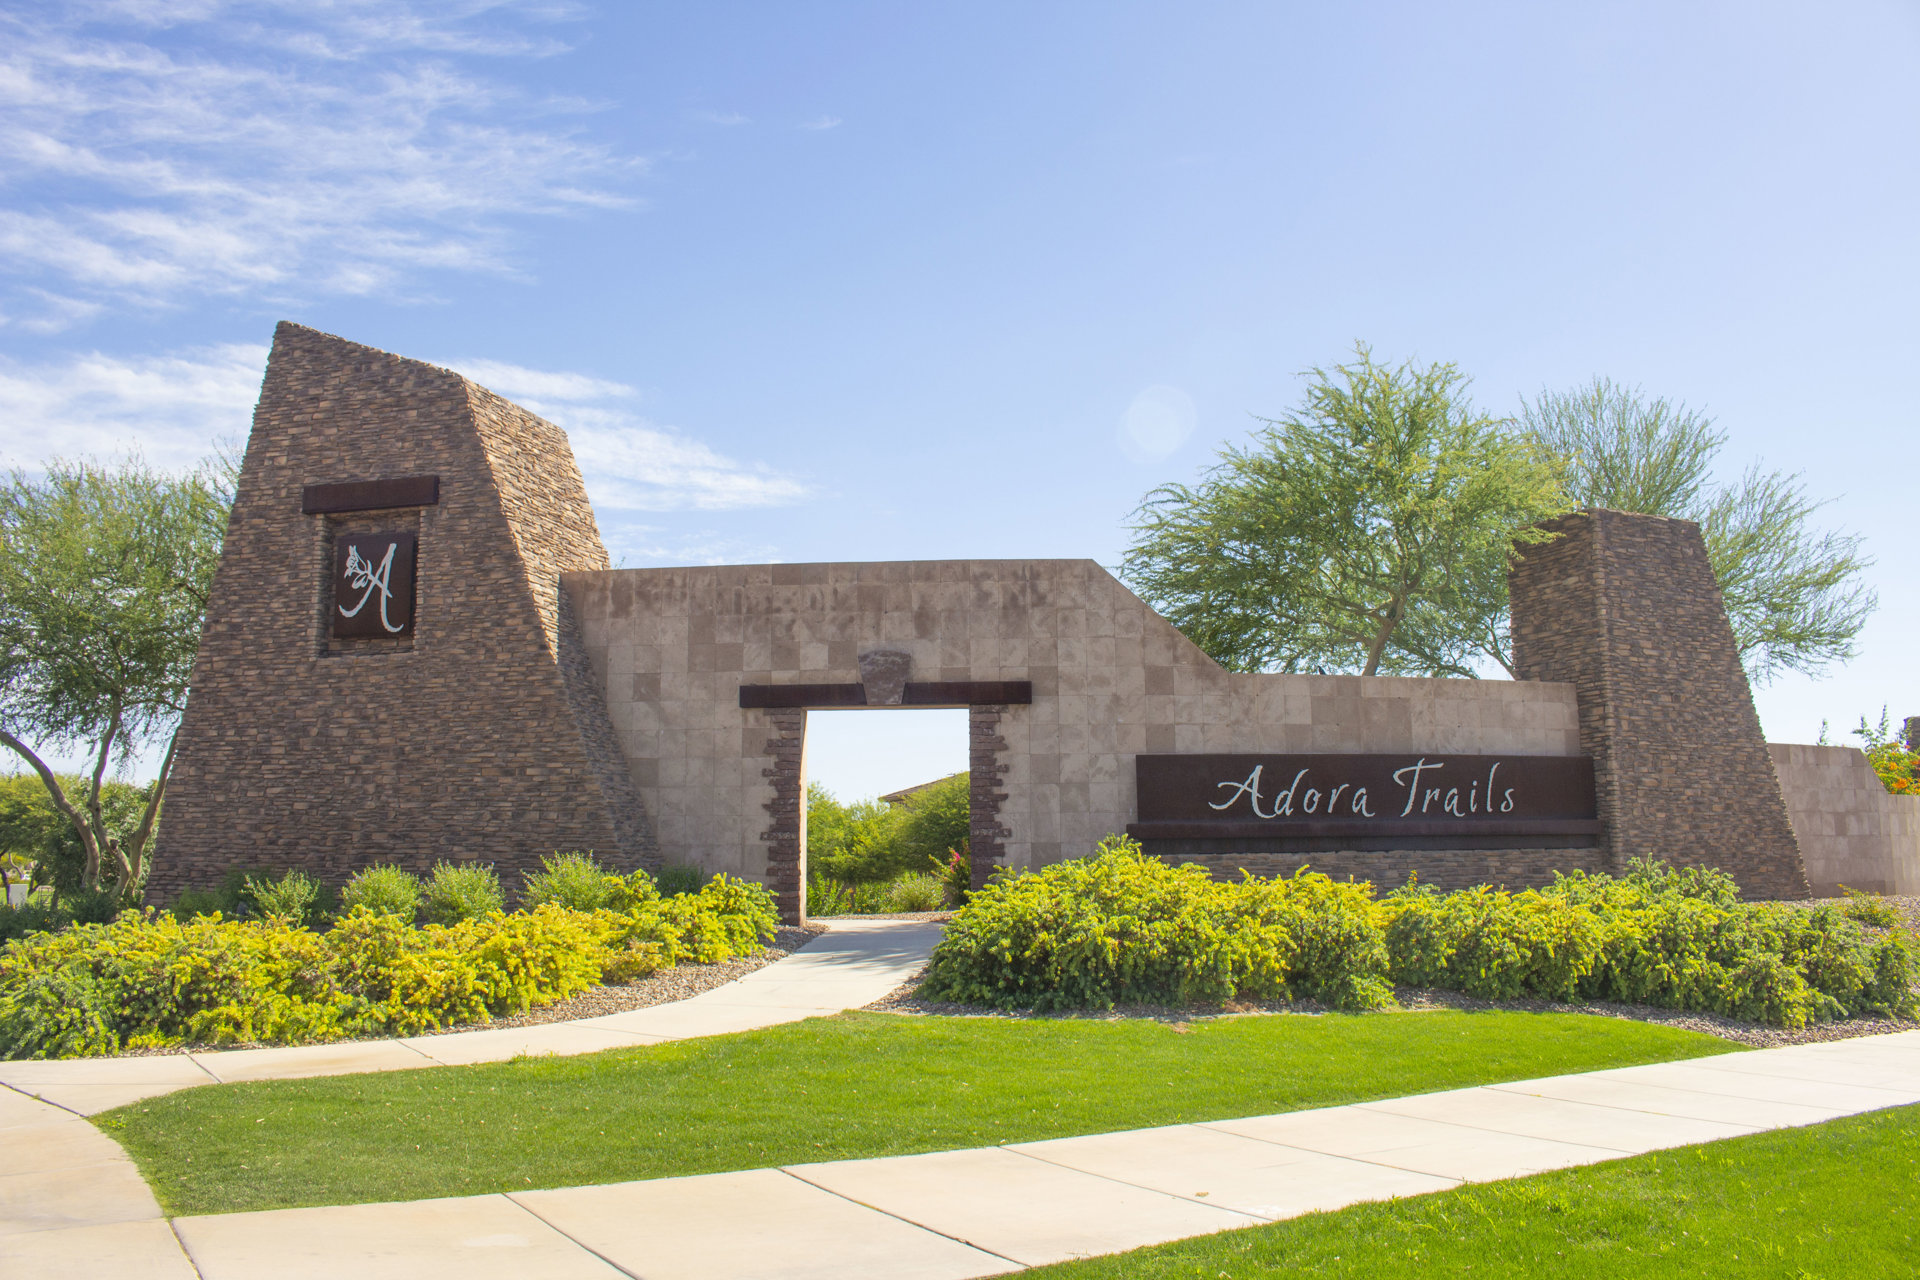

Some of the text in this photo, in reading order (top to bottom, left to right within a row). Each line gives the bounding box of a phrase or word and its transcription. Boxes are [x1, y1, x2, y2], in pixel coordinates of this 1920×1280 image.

[338, 542, 404, 633] A
[1208, 757, 1515, 819] Adora Trails
